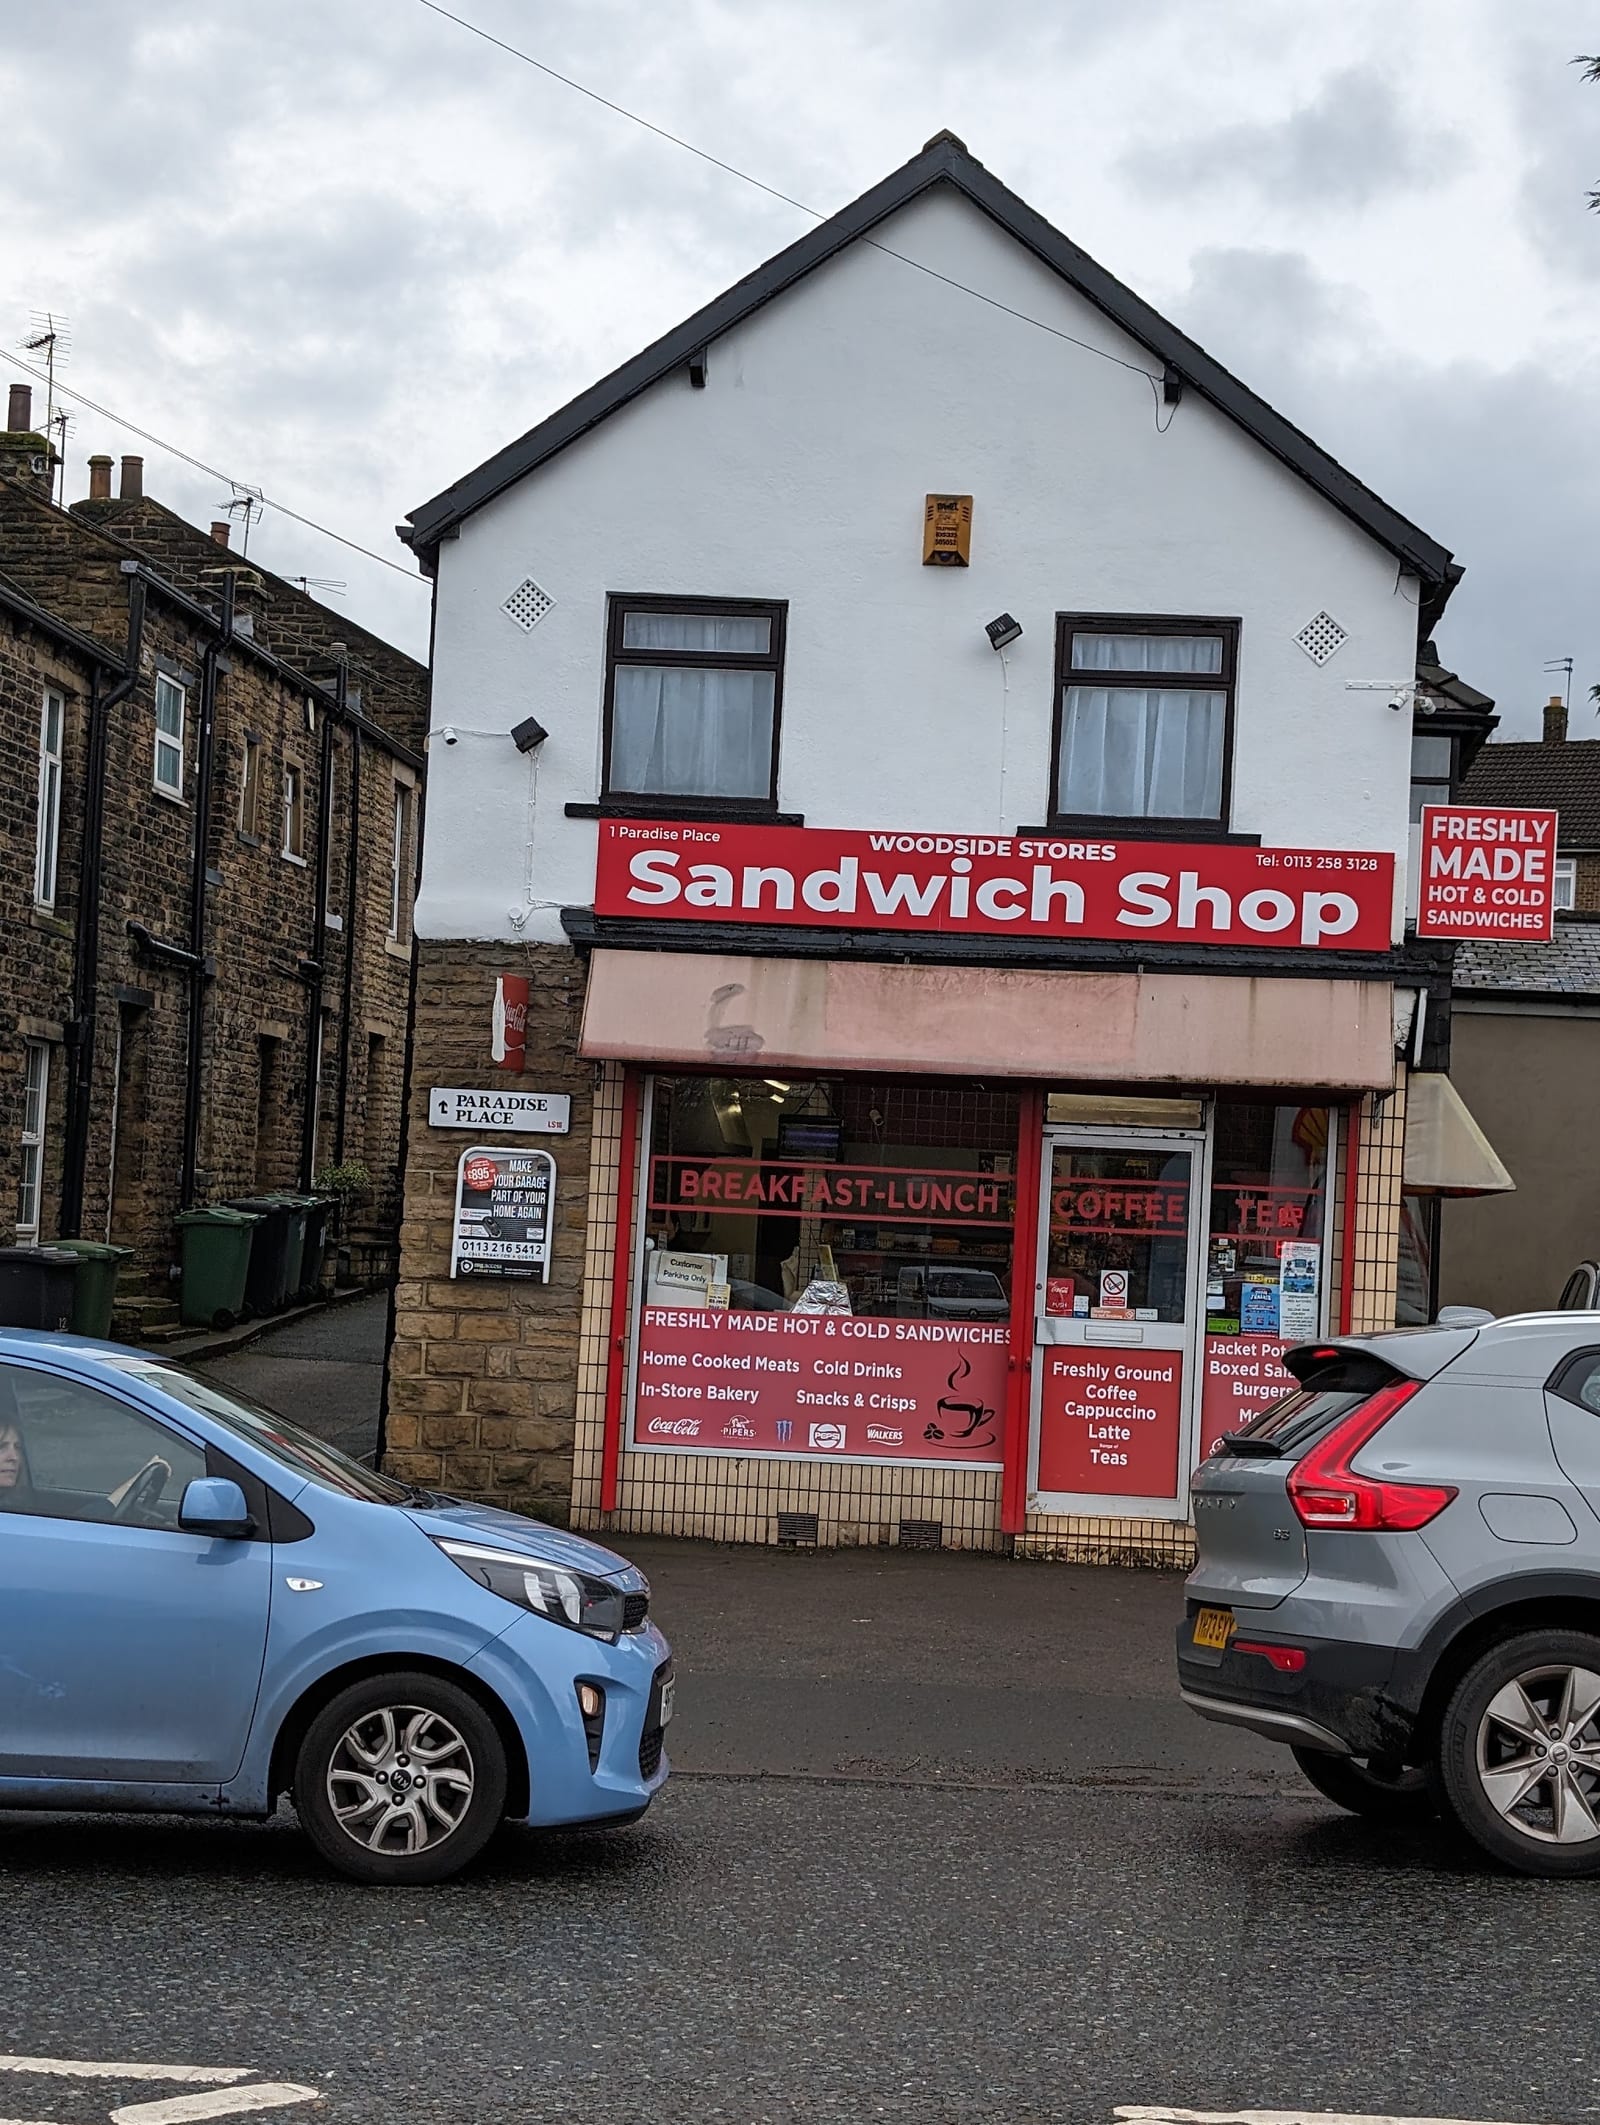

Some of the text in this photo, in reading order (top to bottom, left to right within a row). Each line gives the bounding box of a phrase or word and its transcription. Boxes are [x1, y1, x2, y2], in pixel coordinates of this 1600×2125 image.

[609, 826, 721, 843] 1 Paradise Place
[1431, 815, 1549, 843] FRESHLY
[869, 834, 1117, 862] WOODSIDE STORES
[1255, 854, 1378, 871] Tel: 0113 258 3128
[1429, 845, 1546, 883] MADE
[626, 849, 1360, 946] Sandwich Shop
[1428, 885, 1545, 906] HOT & COLD
[1427, 909, 1544, 929] SANDWICHES
[456, 1094, 548, 1112] PARADISE
[455, 1110, 514, 1125] PLACE
[509, 1160, 532, 1173] MAKE
[493, 1174, 515, 1187] YOUR
[516, 1176, 547, 1189] GARAGE
[491, 1189, 546, 1205] PART OF YOUR
[679, 1169, 999, 1213] BREAKFAST-LUNCH
[493, 1205, 516, 1218] HOME
[517, 1206, 542, 1220] AGAIN
[1053, 1189, 1186, 1223] COFFEE
[462, 1241, 542, 1255] 0113 216 5412
[669, 1258, 704, 1270] Customer
[663, 1269, 707, 1284] Parking Only
[645, 1310, 723, 1330] FRESHLY
[728, 1315, 778, 1333] MADE
[783, 1318, 821, 1335] HOT
[825, 1320, 836, 1336] &
[841, 1321, 890, 1339] COLD
[1209, 1341, 1257, 1356] Jacket
[642, 1350, 800, 1373] Home Cooked Meats
[813, 1360, 903, 1379] Cold Drinks
[1209, 1360, 1259, 1376] Boxed
[1053, 1361, 1173, 1382] Freshly Ground
[641, 1382, 759, 1403] In-Store Bakery
[796, 1389, 917, 1412] Snacks & Crisps
[1085, 1384, 1137, 1401] Coffee
[1065, 1401, 1157, 1420] Cappuccino
[648, 1416, 702, 1436] Coca-Cola
[723, 1428, 755, 1438] PIPERS
[867, 1428, 903, 1440] WALKERS
[1088, 1424, 1131, 1441] Latte
[814, 1431, 841, 1441] PEPSI
[1090, 1449, 1128, 1465] Teas
